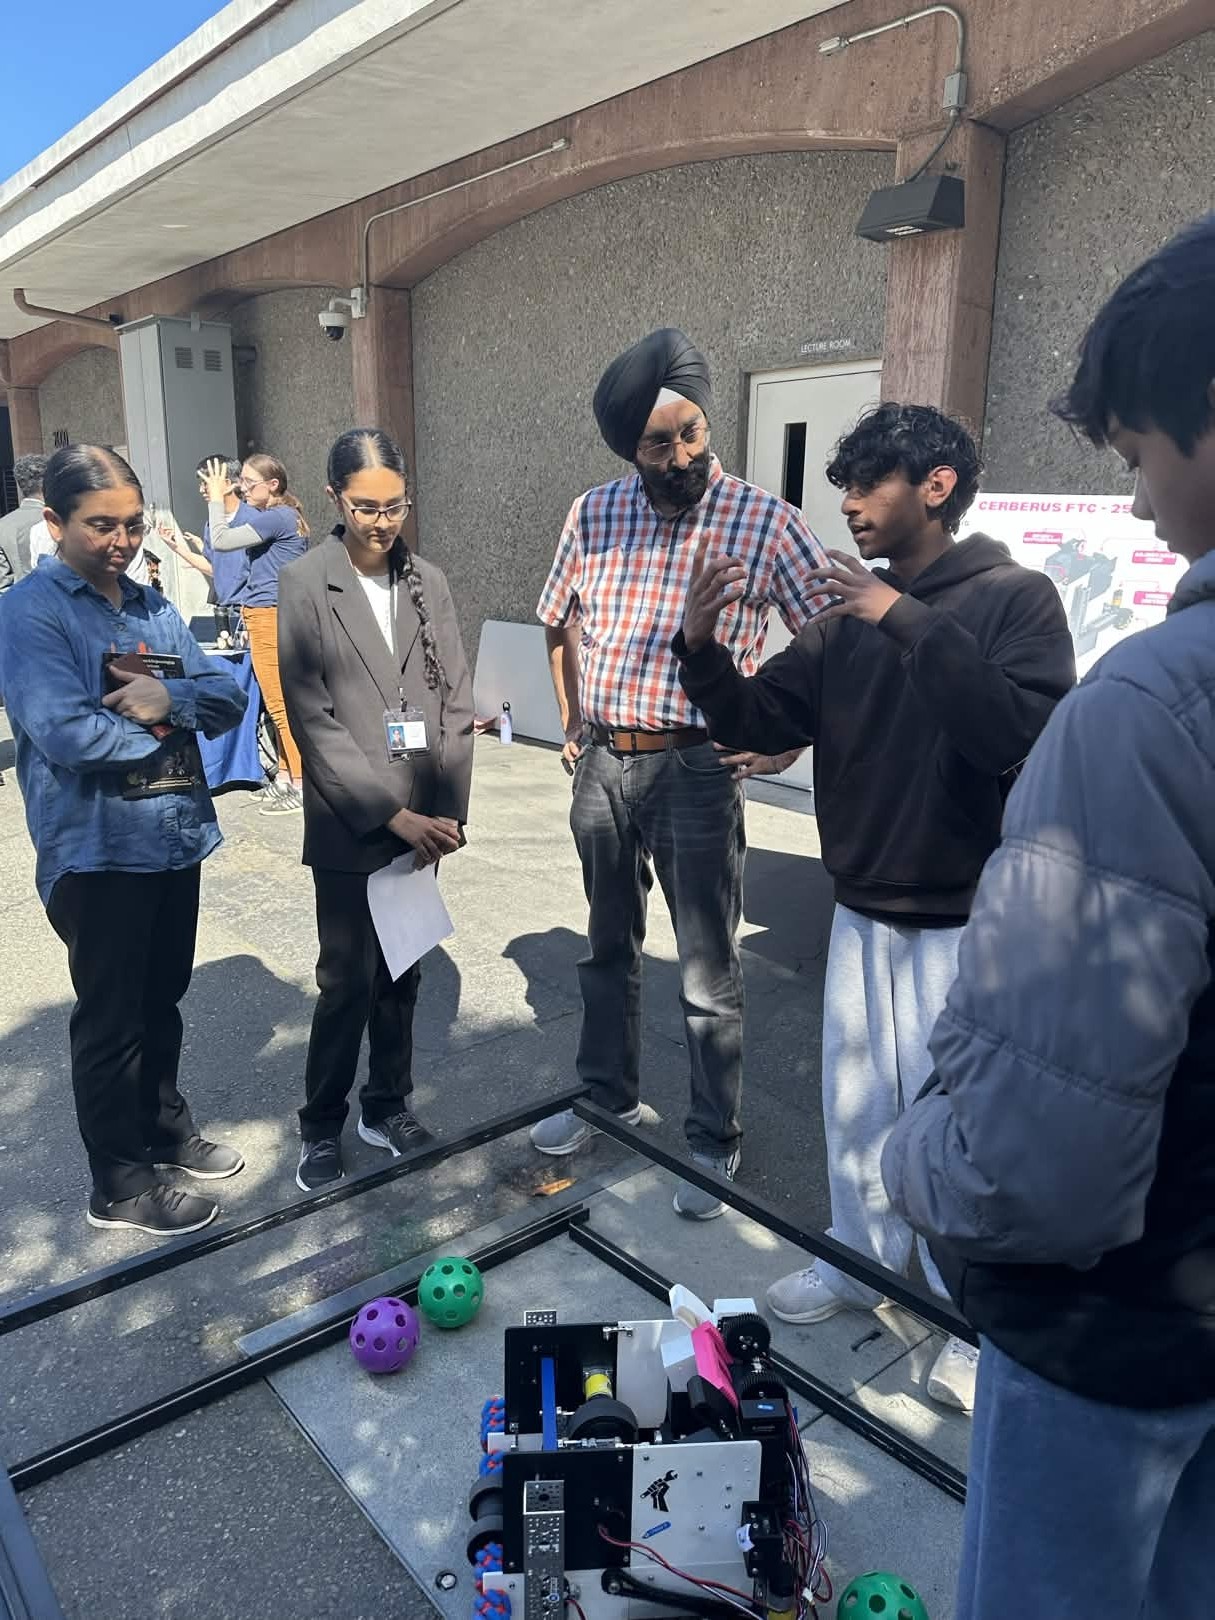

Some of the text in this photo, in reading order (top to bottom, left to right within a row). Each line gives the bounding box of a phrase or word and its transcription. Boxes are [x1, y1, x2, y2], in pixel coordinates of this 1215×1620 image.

[830, 339, 851, 350] ROOM
[978, 501, 1062, 512] CERBERUS
[1065, 503, 1097, 513] FTC
